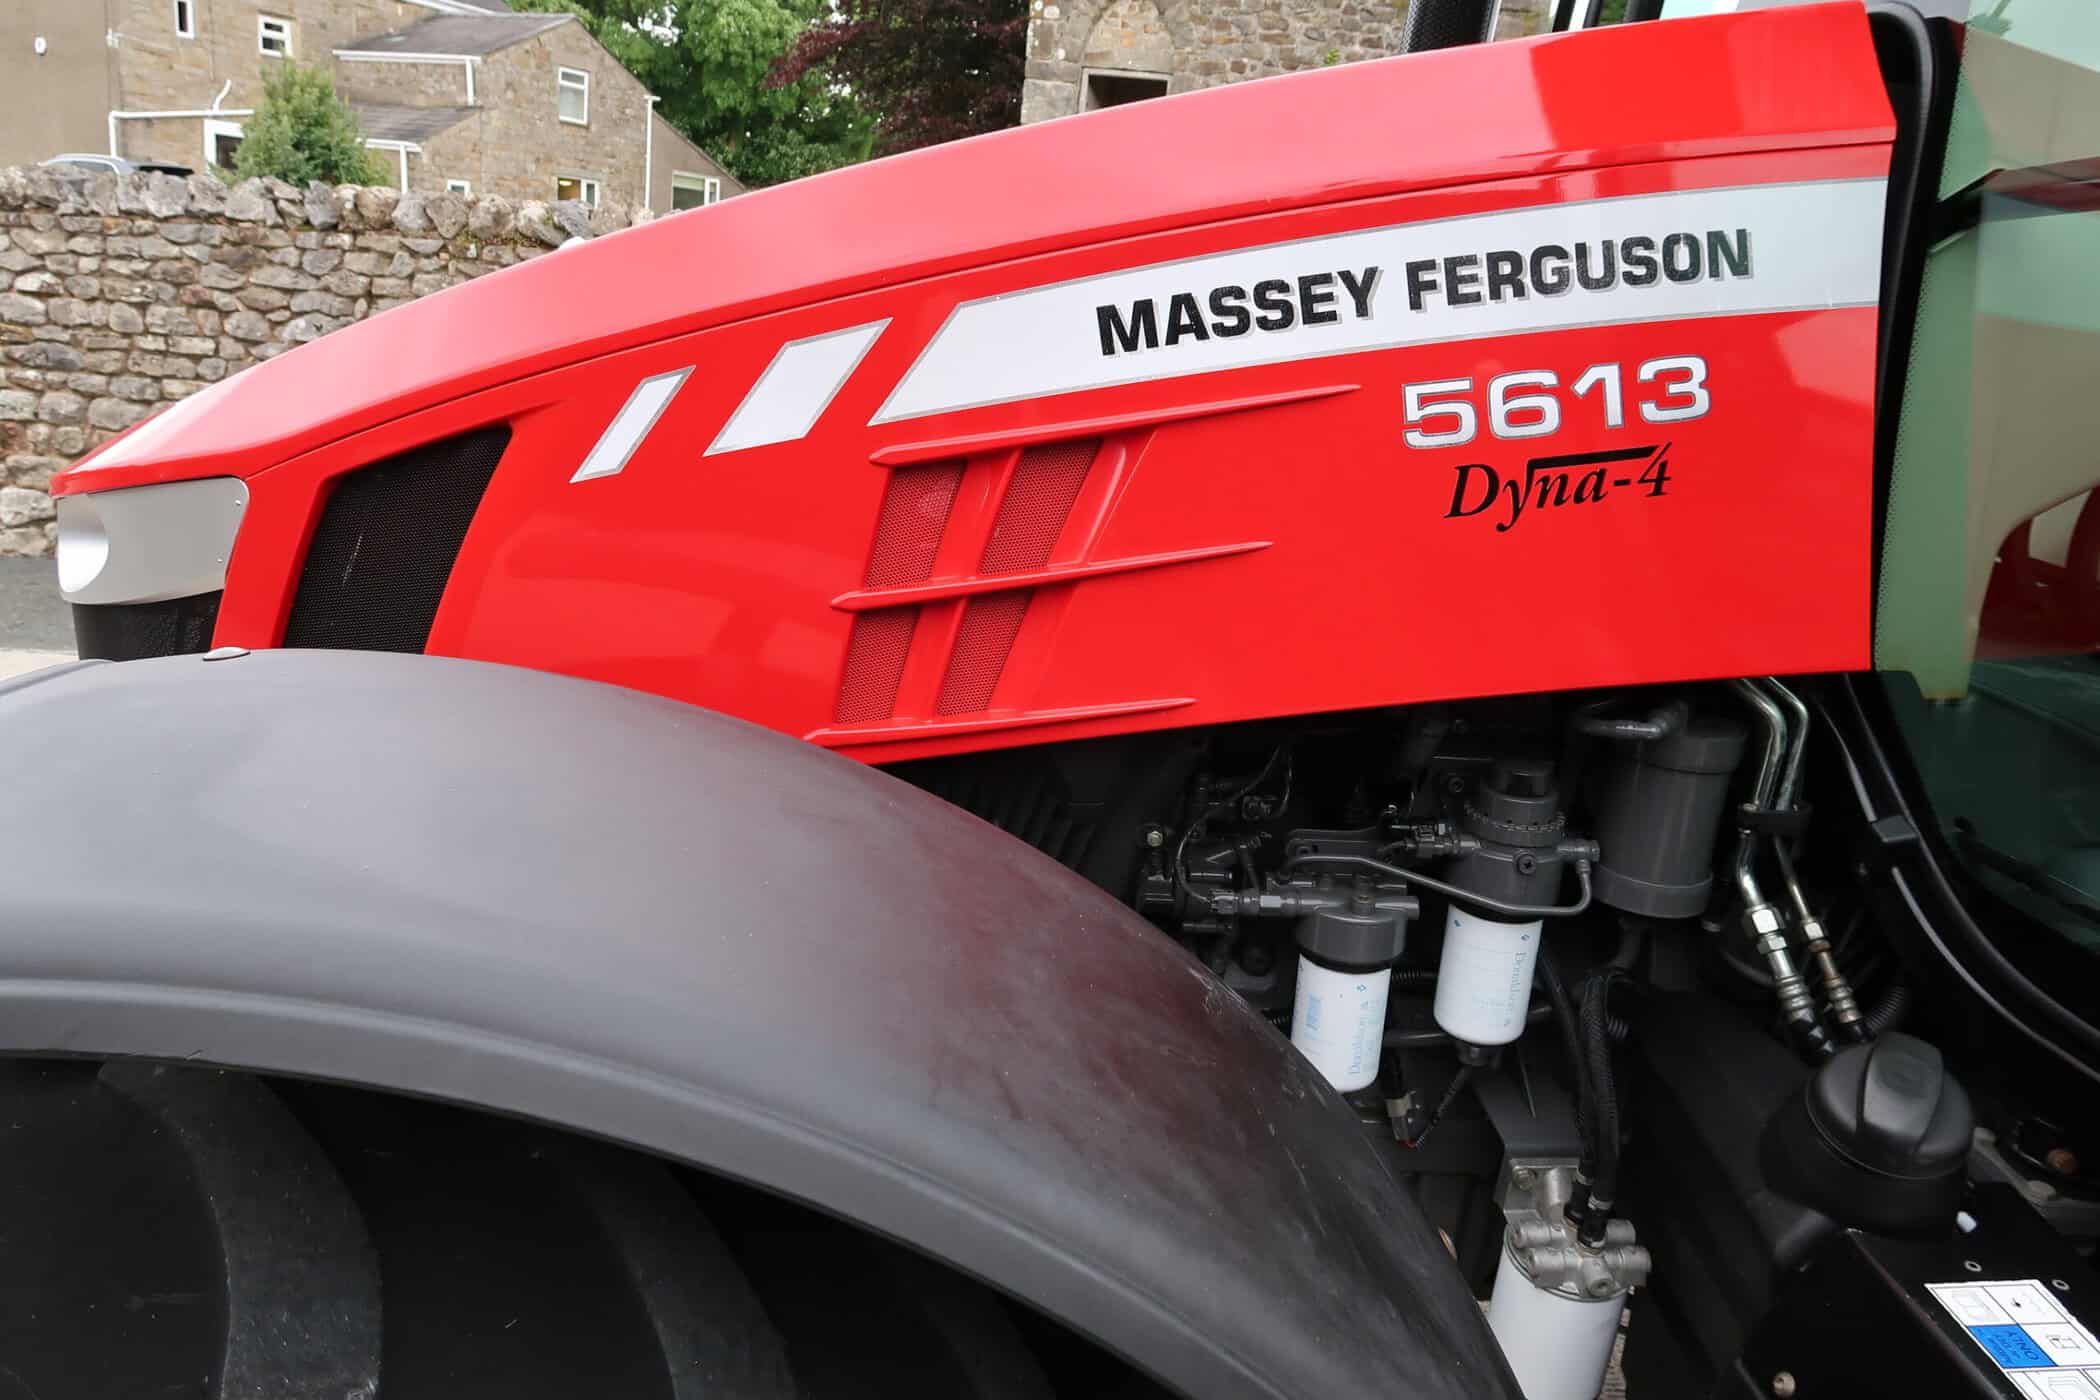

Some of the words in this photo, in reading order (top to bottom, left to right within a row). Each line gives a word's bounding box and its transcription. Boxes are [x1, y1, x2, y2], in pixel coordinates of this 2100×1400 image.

[1095, 266, 1382, 356] MASSEY
[1405, 228, 1752, 312] FERGUSON
[1402, 354, 1711, 449] 5613
[1444, 442, 1672, 532] Dyna-4
